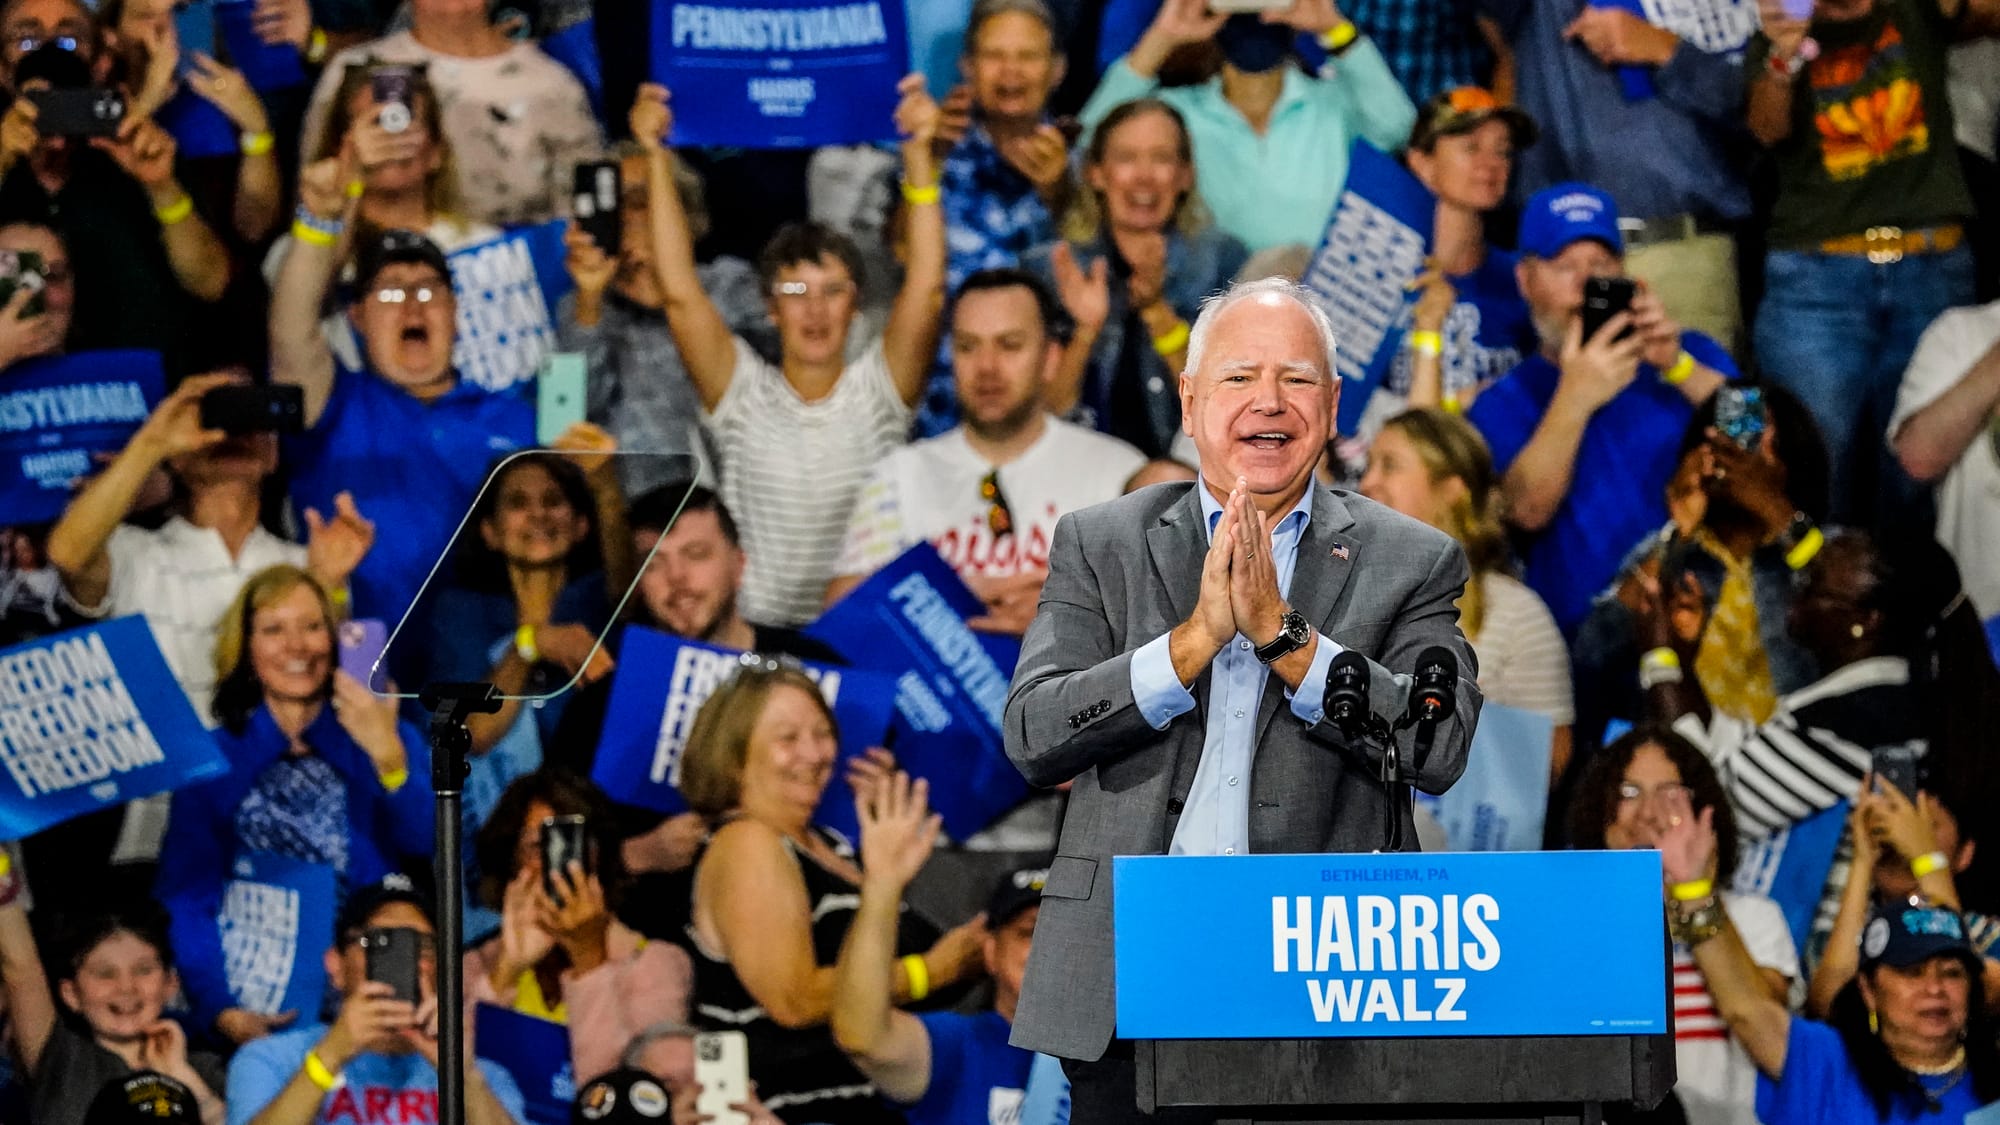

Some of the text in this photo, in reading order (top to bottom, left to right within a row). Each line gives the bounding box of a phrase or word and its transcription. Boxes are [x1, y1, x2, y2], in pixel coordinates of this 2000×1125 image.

[672, 2, 887, 51] PENNSYLVANIA
[4, 721, 165, 798] FREEDOM
[1321, 868, 1449, 882] BETHLEHEM, PA
[1272, 893, 1501, 972] HARRIS
[1306, 978, 1467, 1022] WALZ
